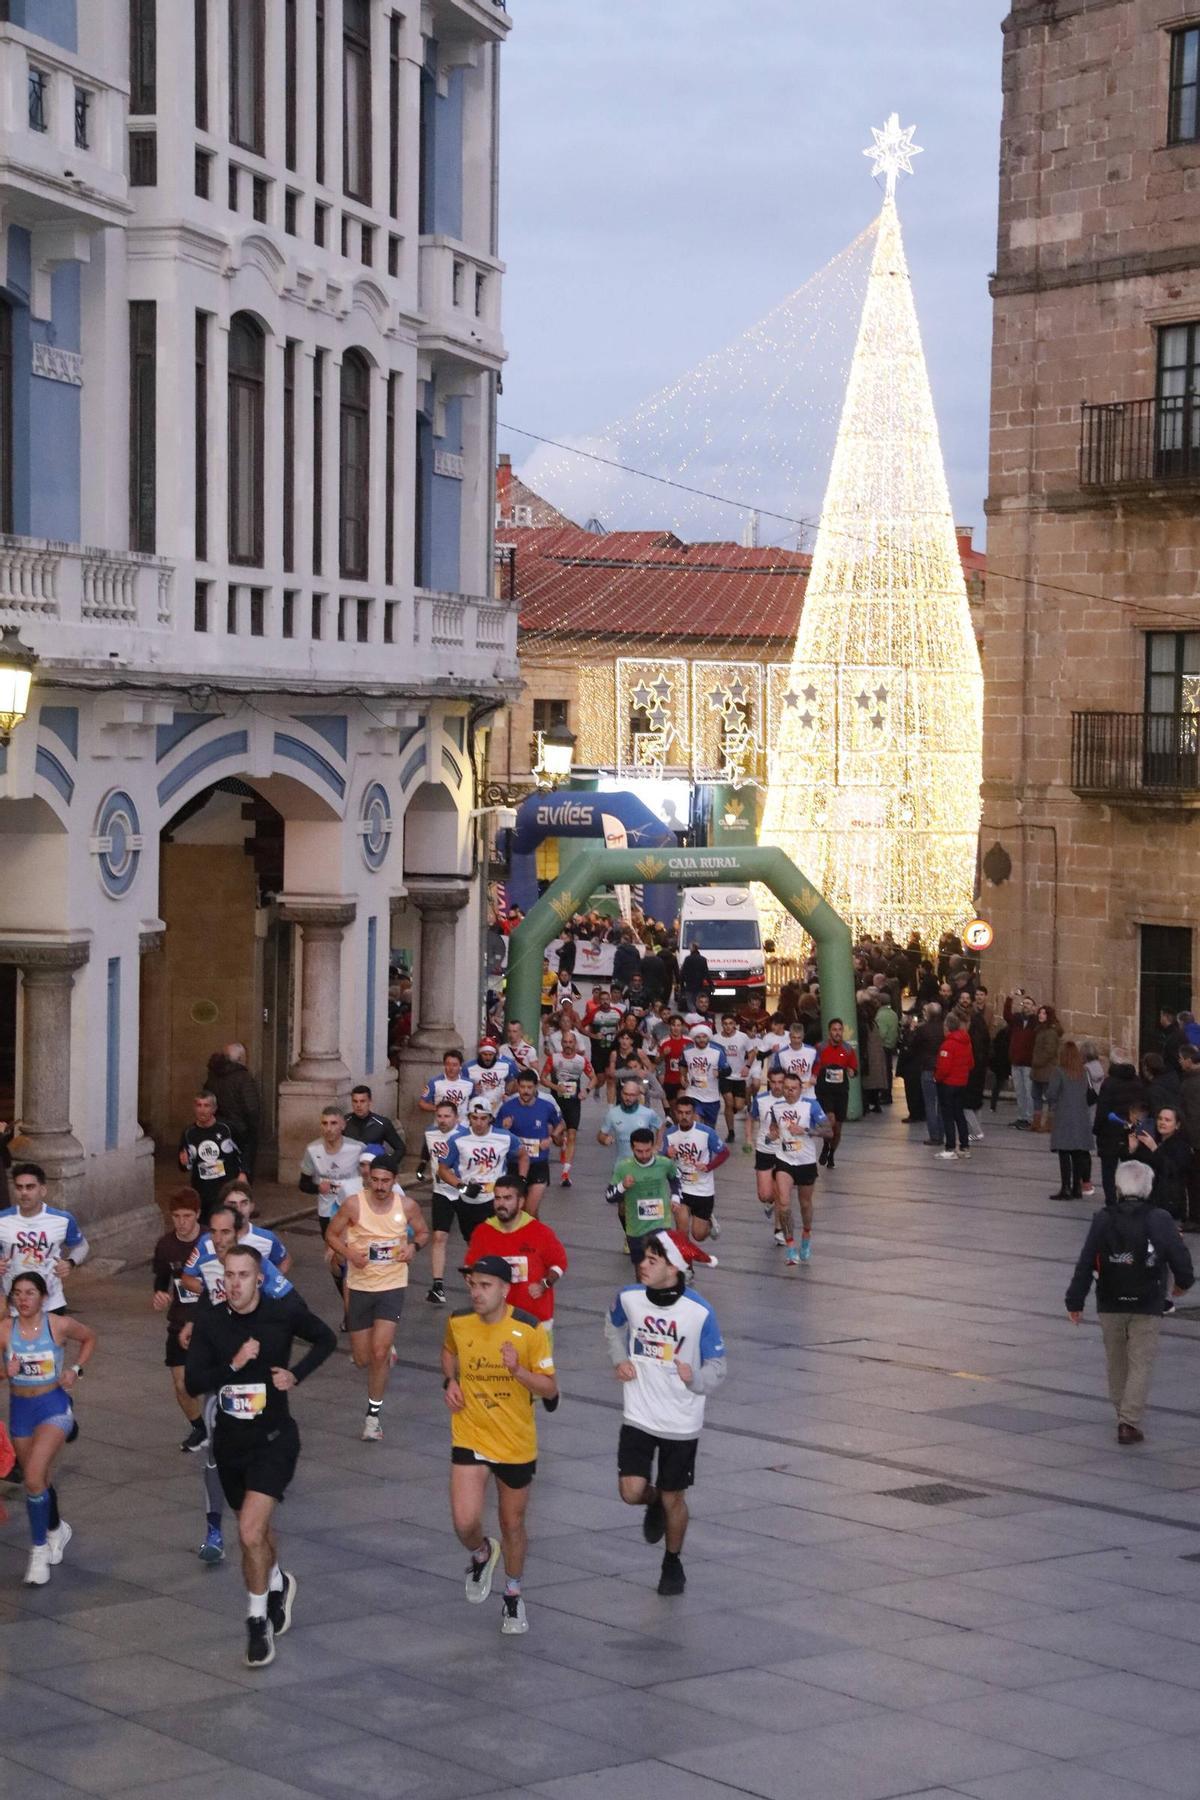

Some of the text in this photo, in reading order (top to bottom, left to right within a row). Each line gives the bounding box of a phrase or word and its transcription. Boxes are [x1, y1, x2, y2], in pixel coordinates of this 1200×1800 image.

[537, 801, 594, 825] avilés
[669, 856, 740, 869] CAJA RURAL
[693, 1057, 708, 1067] SSA
[791, 1058, 807, 1069] SSA
[481, 1071, 498, 1083] SSA
[446, 1089, 463, 1101] SSA
[783, 1110, 798, 1120] SSA
[472, 1147, 496, 1162] SSA
[678, 1142, 698, 1155] SSA
[16, 1231, 48, 1250] SSA
[22, 1247, 43, 1265] 25
[643, 1315, 678, 1343] SSA
